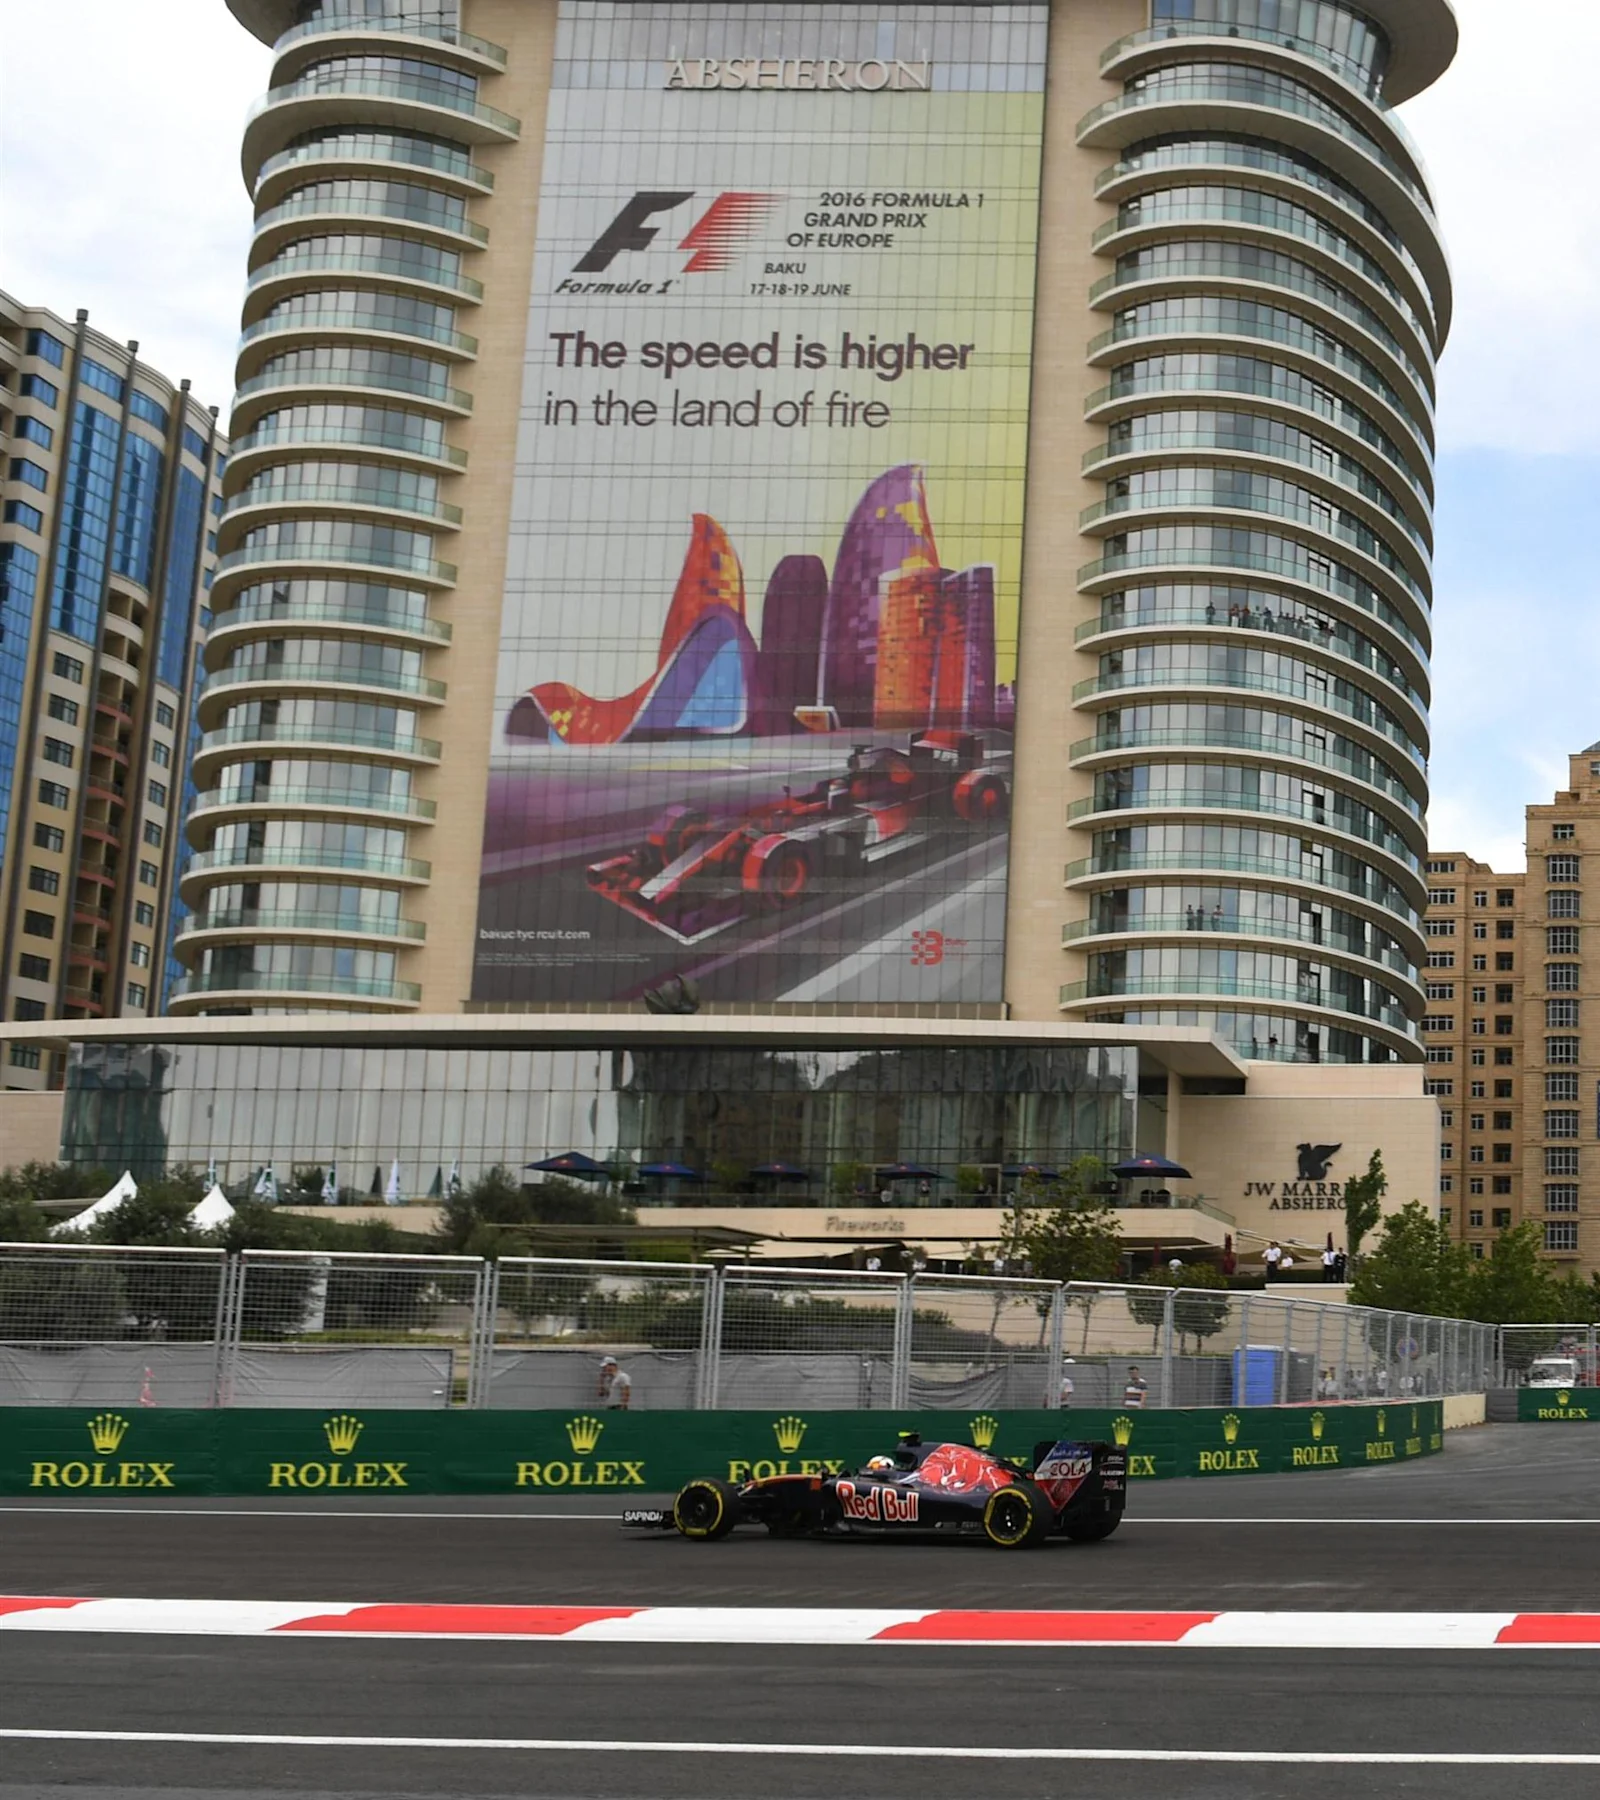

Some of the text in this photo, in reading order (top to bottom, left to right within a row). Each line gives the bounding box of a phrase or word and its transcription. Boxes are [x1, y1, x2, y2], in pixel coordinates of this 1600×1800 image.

[663, 56, 932, 91] ABSHERON
[819, 192, 985, 208] 2016 FORMULA 1
[804, 212, 928, 229] GRAND PRIX
[786, 233, 894, 249] OF EUROPE
[764, 262, 806, 275] BAKU
[555, 278, 653, 295] Formula
[749, 282, 852, 297] 17-18-19 JUNE
[549, 331, 975, 380] The speed is higher
[544, 390, 891, 428] in the land of fire
[1244, 1182, 1389, 1197] JW MARRT
[1269, 1197, 1348, 1210] ABSHERO
[1538, 1408, 1588, 1419] ROLEX
[1200, 1449, 1259, 1470] ROLEX
[1293, 1446, 1339, 1465] ROLEX
[30, 1461, 174, 1488] ROLEX
[269, 1462, 408, 1487] ROLEX
[517, 1462, 645, 1485] ROLEX
[1050, 1463, 1087, 1476] COLA
[836, 1480, 919, 1522] Red Bull
